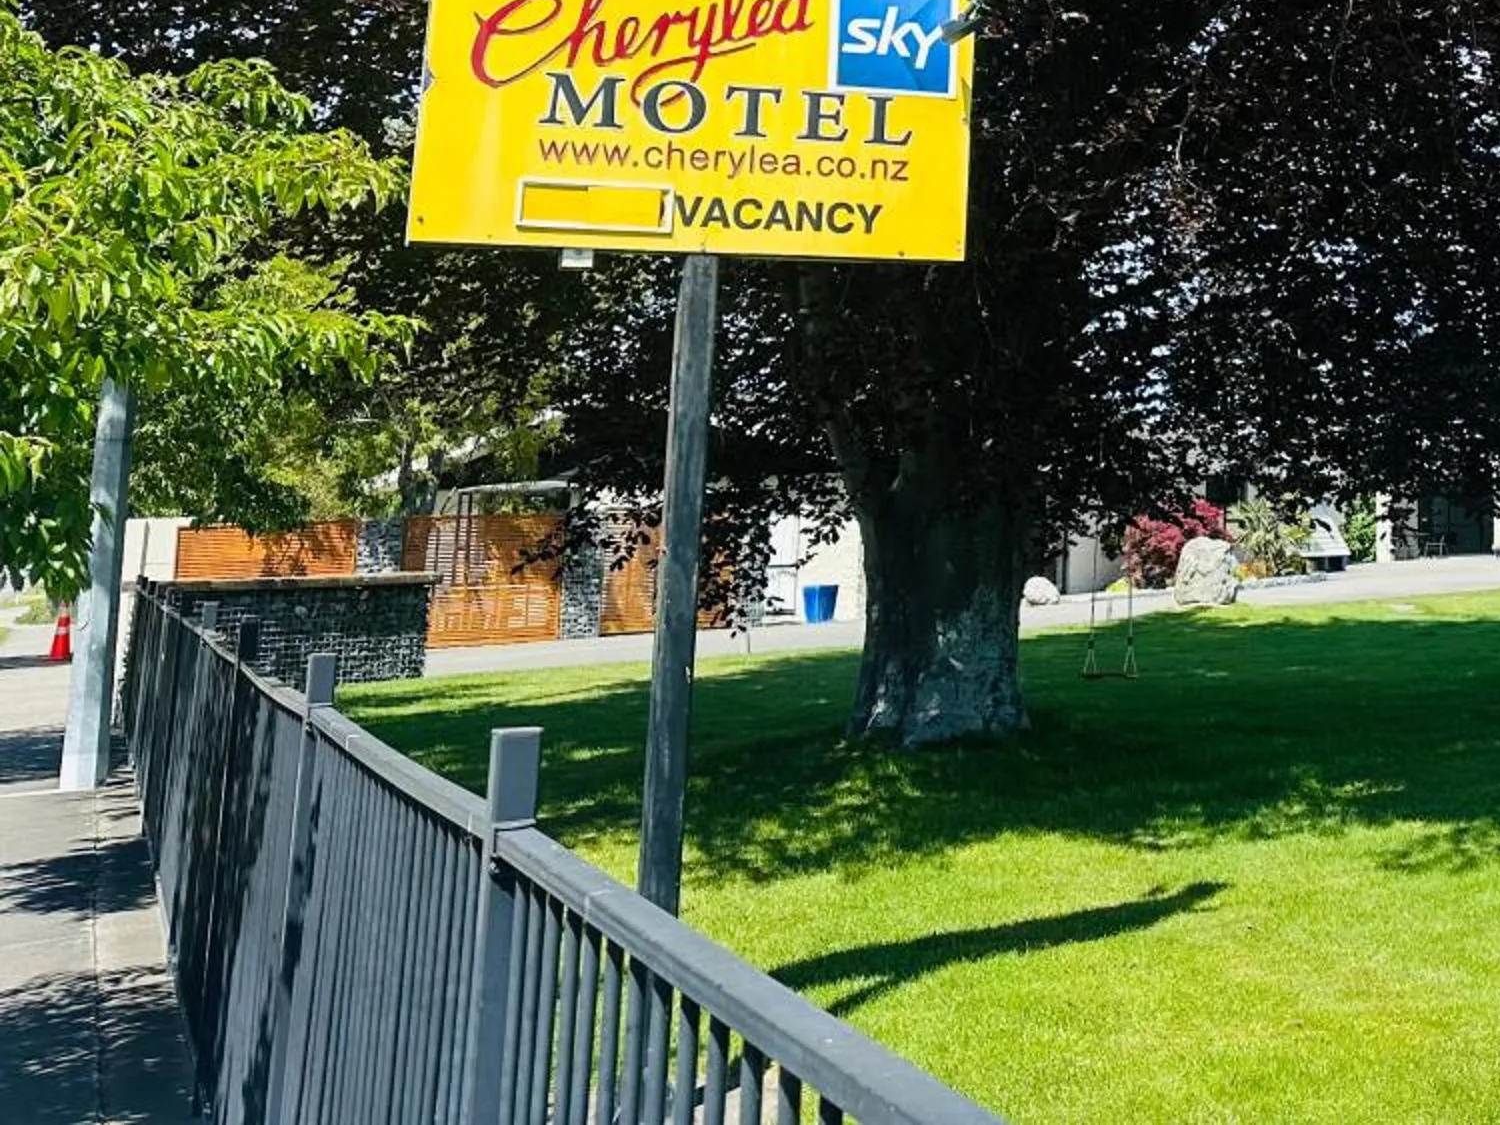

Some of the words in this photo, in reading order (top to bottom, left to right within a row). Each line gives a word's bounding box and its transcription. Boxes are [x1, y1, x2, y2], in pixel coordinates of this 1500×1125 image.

[842, 6, 943, 70] sky
[539, 72, 913, 146] MOTEL
[539, 138, 910, 181] www.cherylea.co.nz
[675, 195, 883, 235] VACANCY
